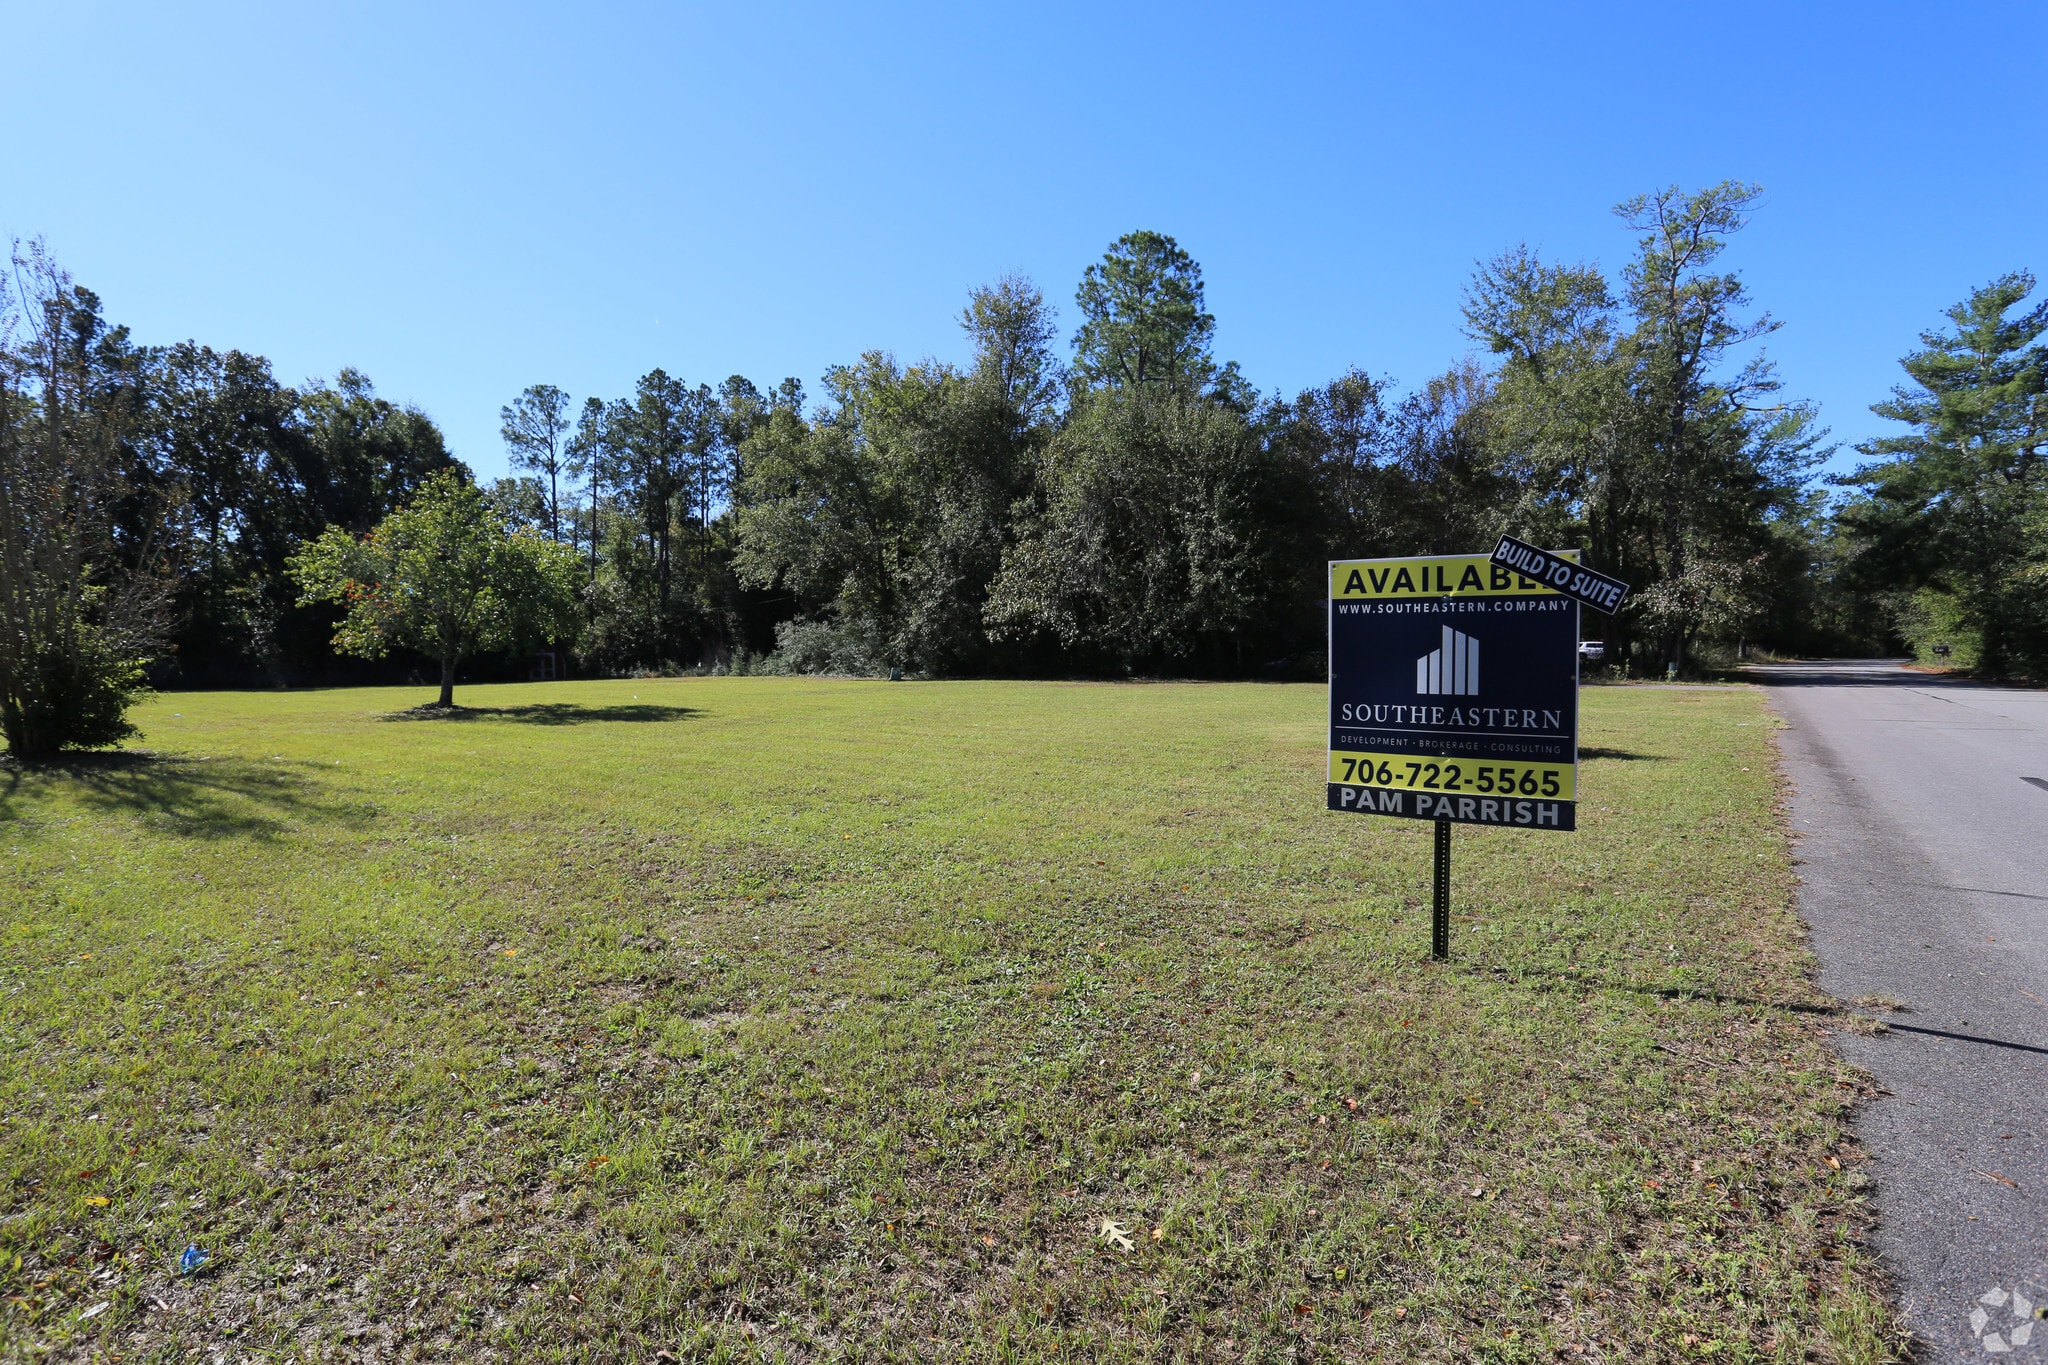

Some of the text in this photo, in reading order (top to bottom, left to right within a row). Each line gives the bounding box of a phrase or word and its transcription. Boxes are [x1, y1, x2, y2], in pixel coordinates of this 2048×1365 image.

[1343, 564, 1550, 594] AVAILABL
[1495, 540, 1622, 607] BUILD TO SUITE
[1338, 600, 1569, 615] WWW.SOUTHEASTERN.COMPANY
[1341, 703, 1562, 729] SOUTHEASTERN
[1341, 735, 1561, 754] DEVELOPMENT BROKERAGE CONSULTING
[1341, 758, 1560, 797] 706-722-5565
[1340, 787, 1559, 826] PAM PARRISH
